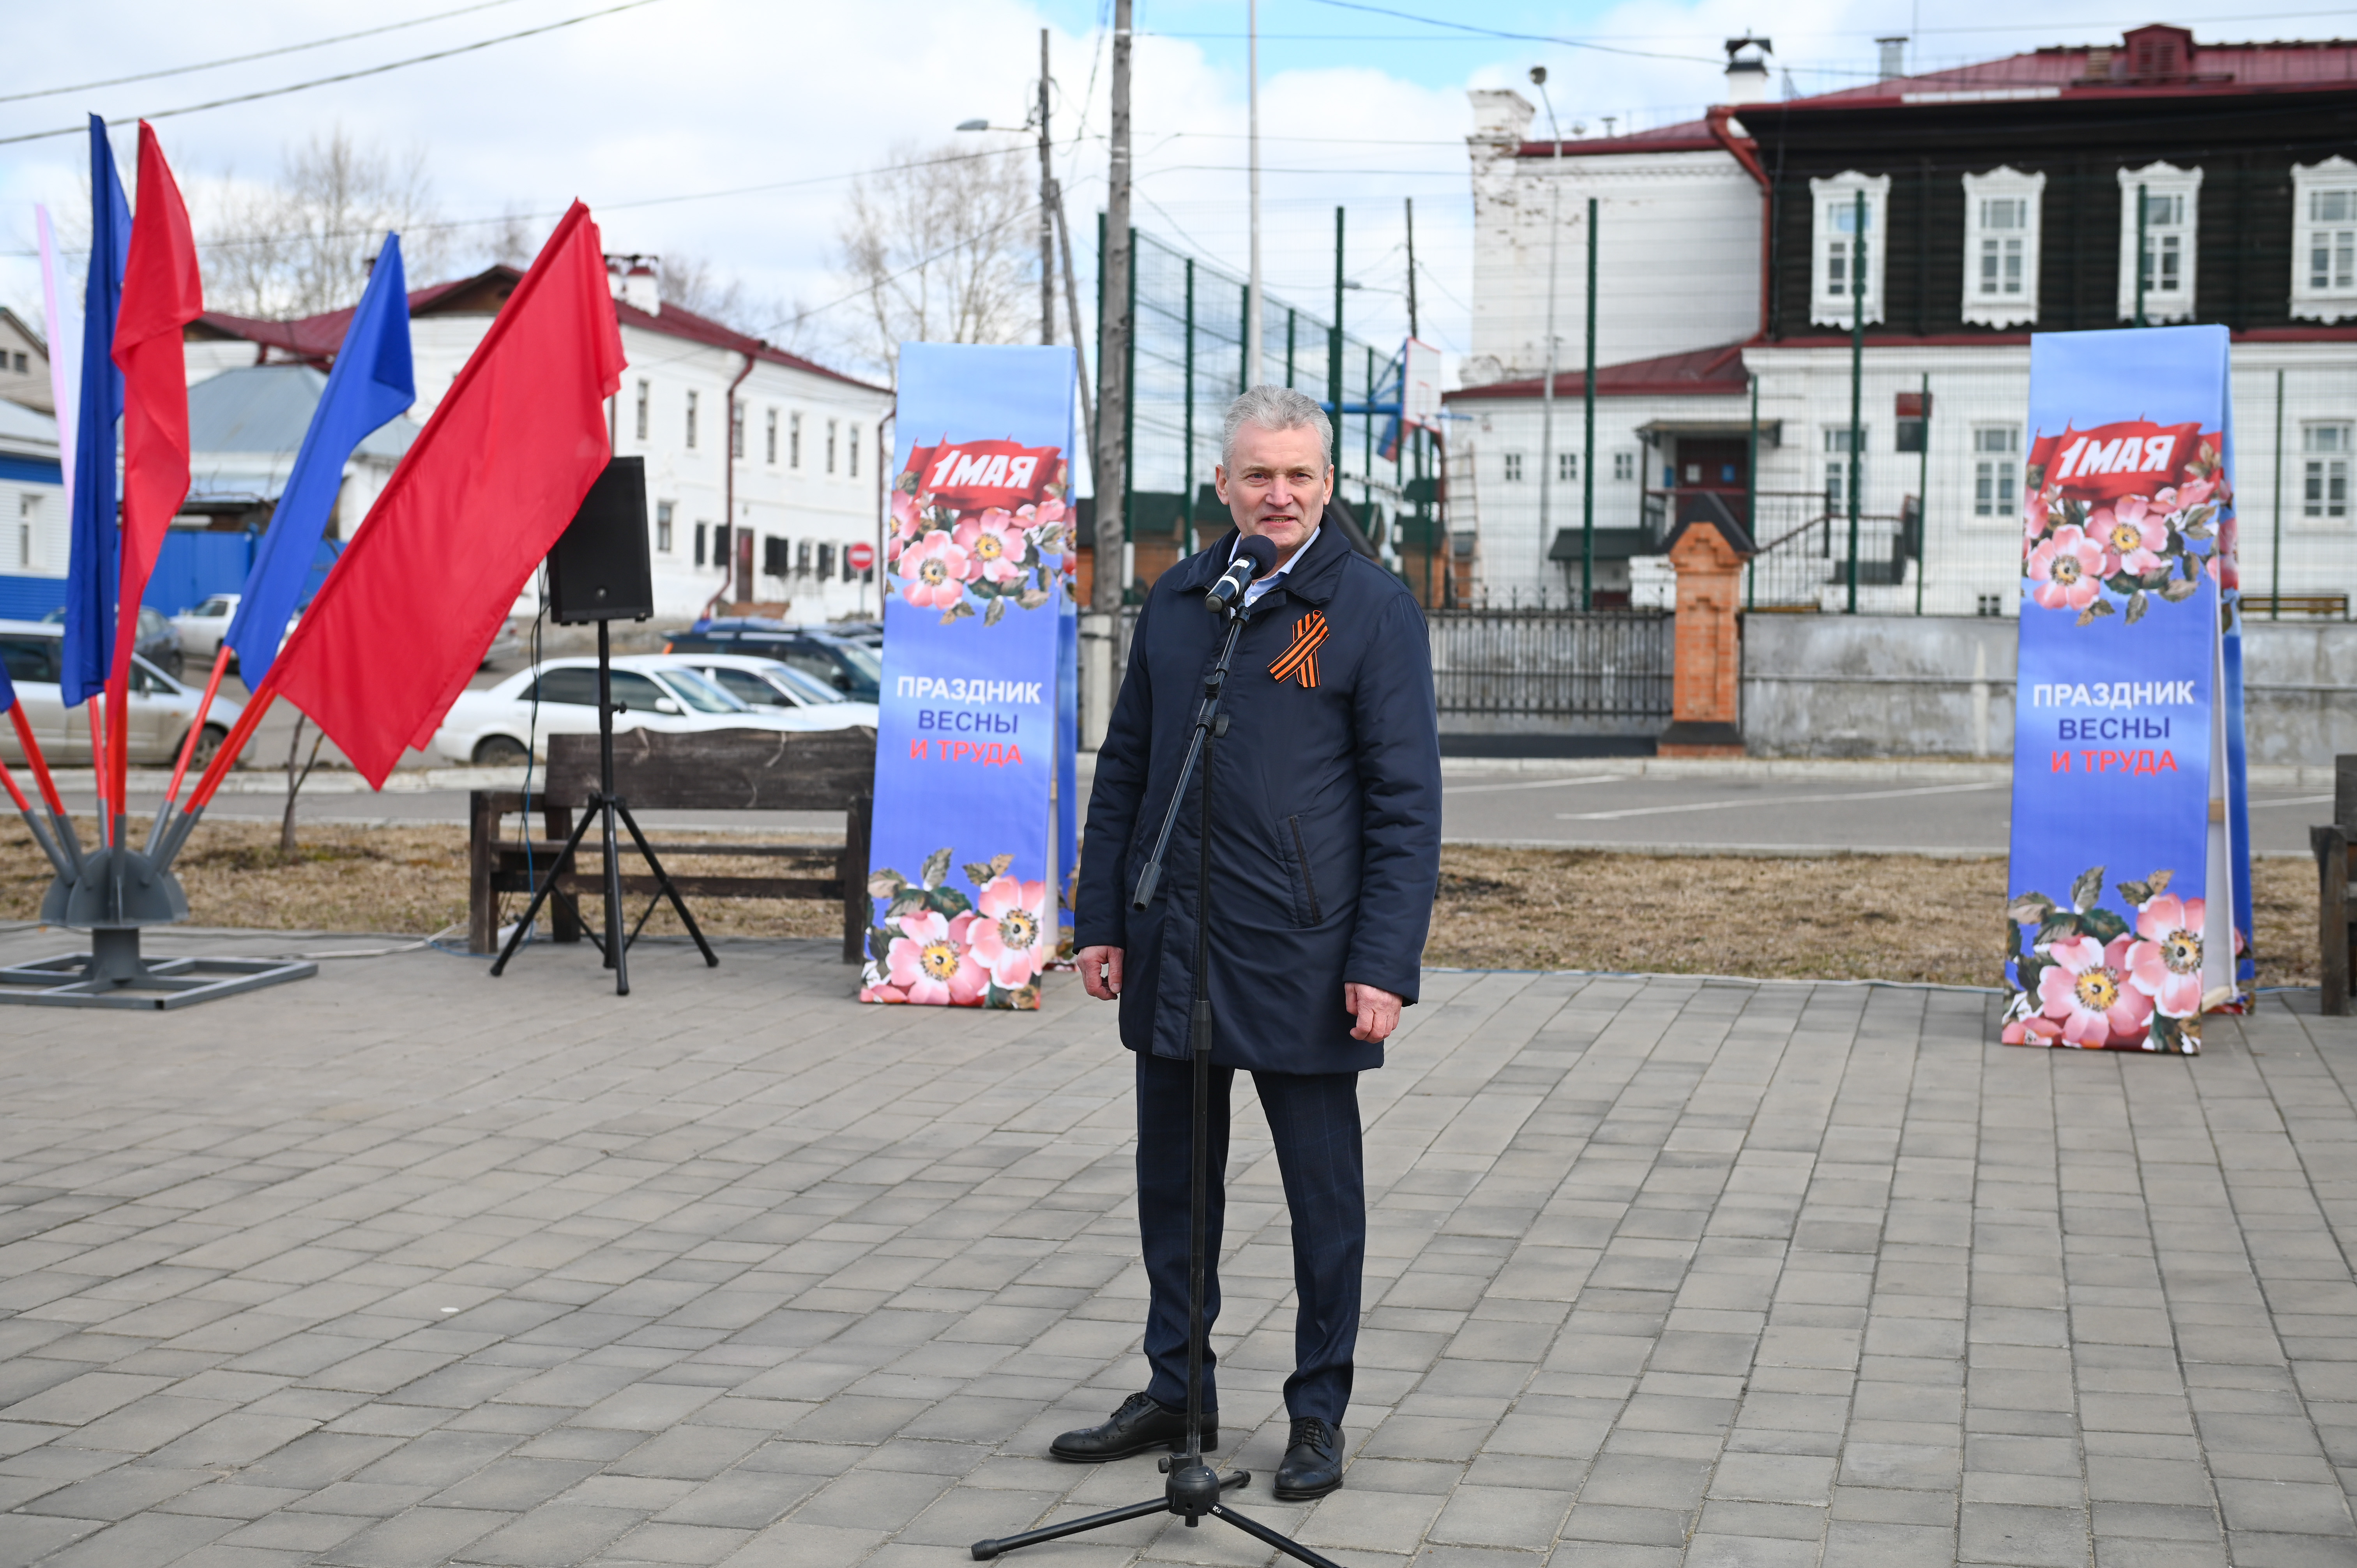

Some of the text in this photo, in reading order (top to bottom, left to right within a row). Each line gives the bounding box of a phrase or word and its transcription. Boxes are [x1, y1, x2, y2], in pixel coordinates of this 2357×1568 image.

[897, 676, 1042, 705] ПРАЗДНИК
[2033, 680, 2195, 710] ПРАЗДНИК
[919, 710, 1018, 733] ВЕСНЫ
[2059, 716, 2170, 740] ВЕСНЫ
[910, 738, 1023, 767] И ТРУДА
[2051, 749, 2178, 776] И ТРУДА
